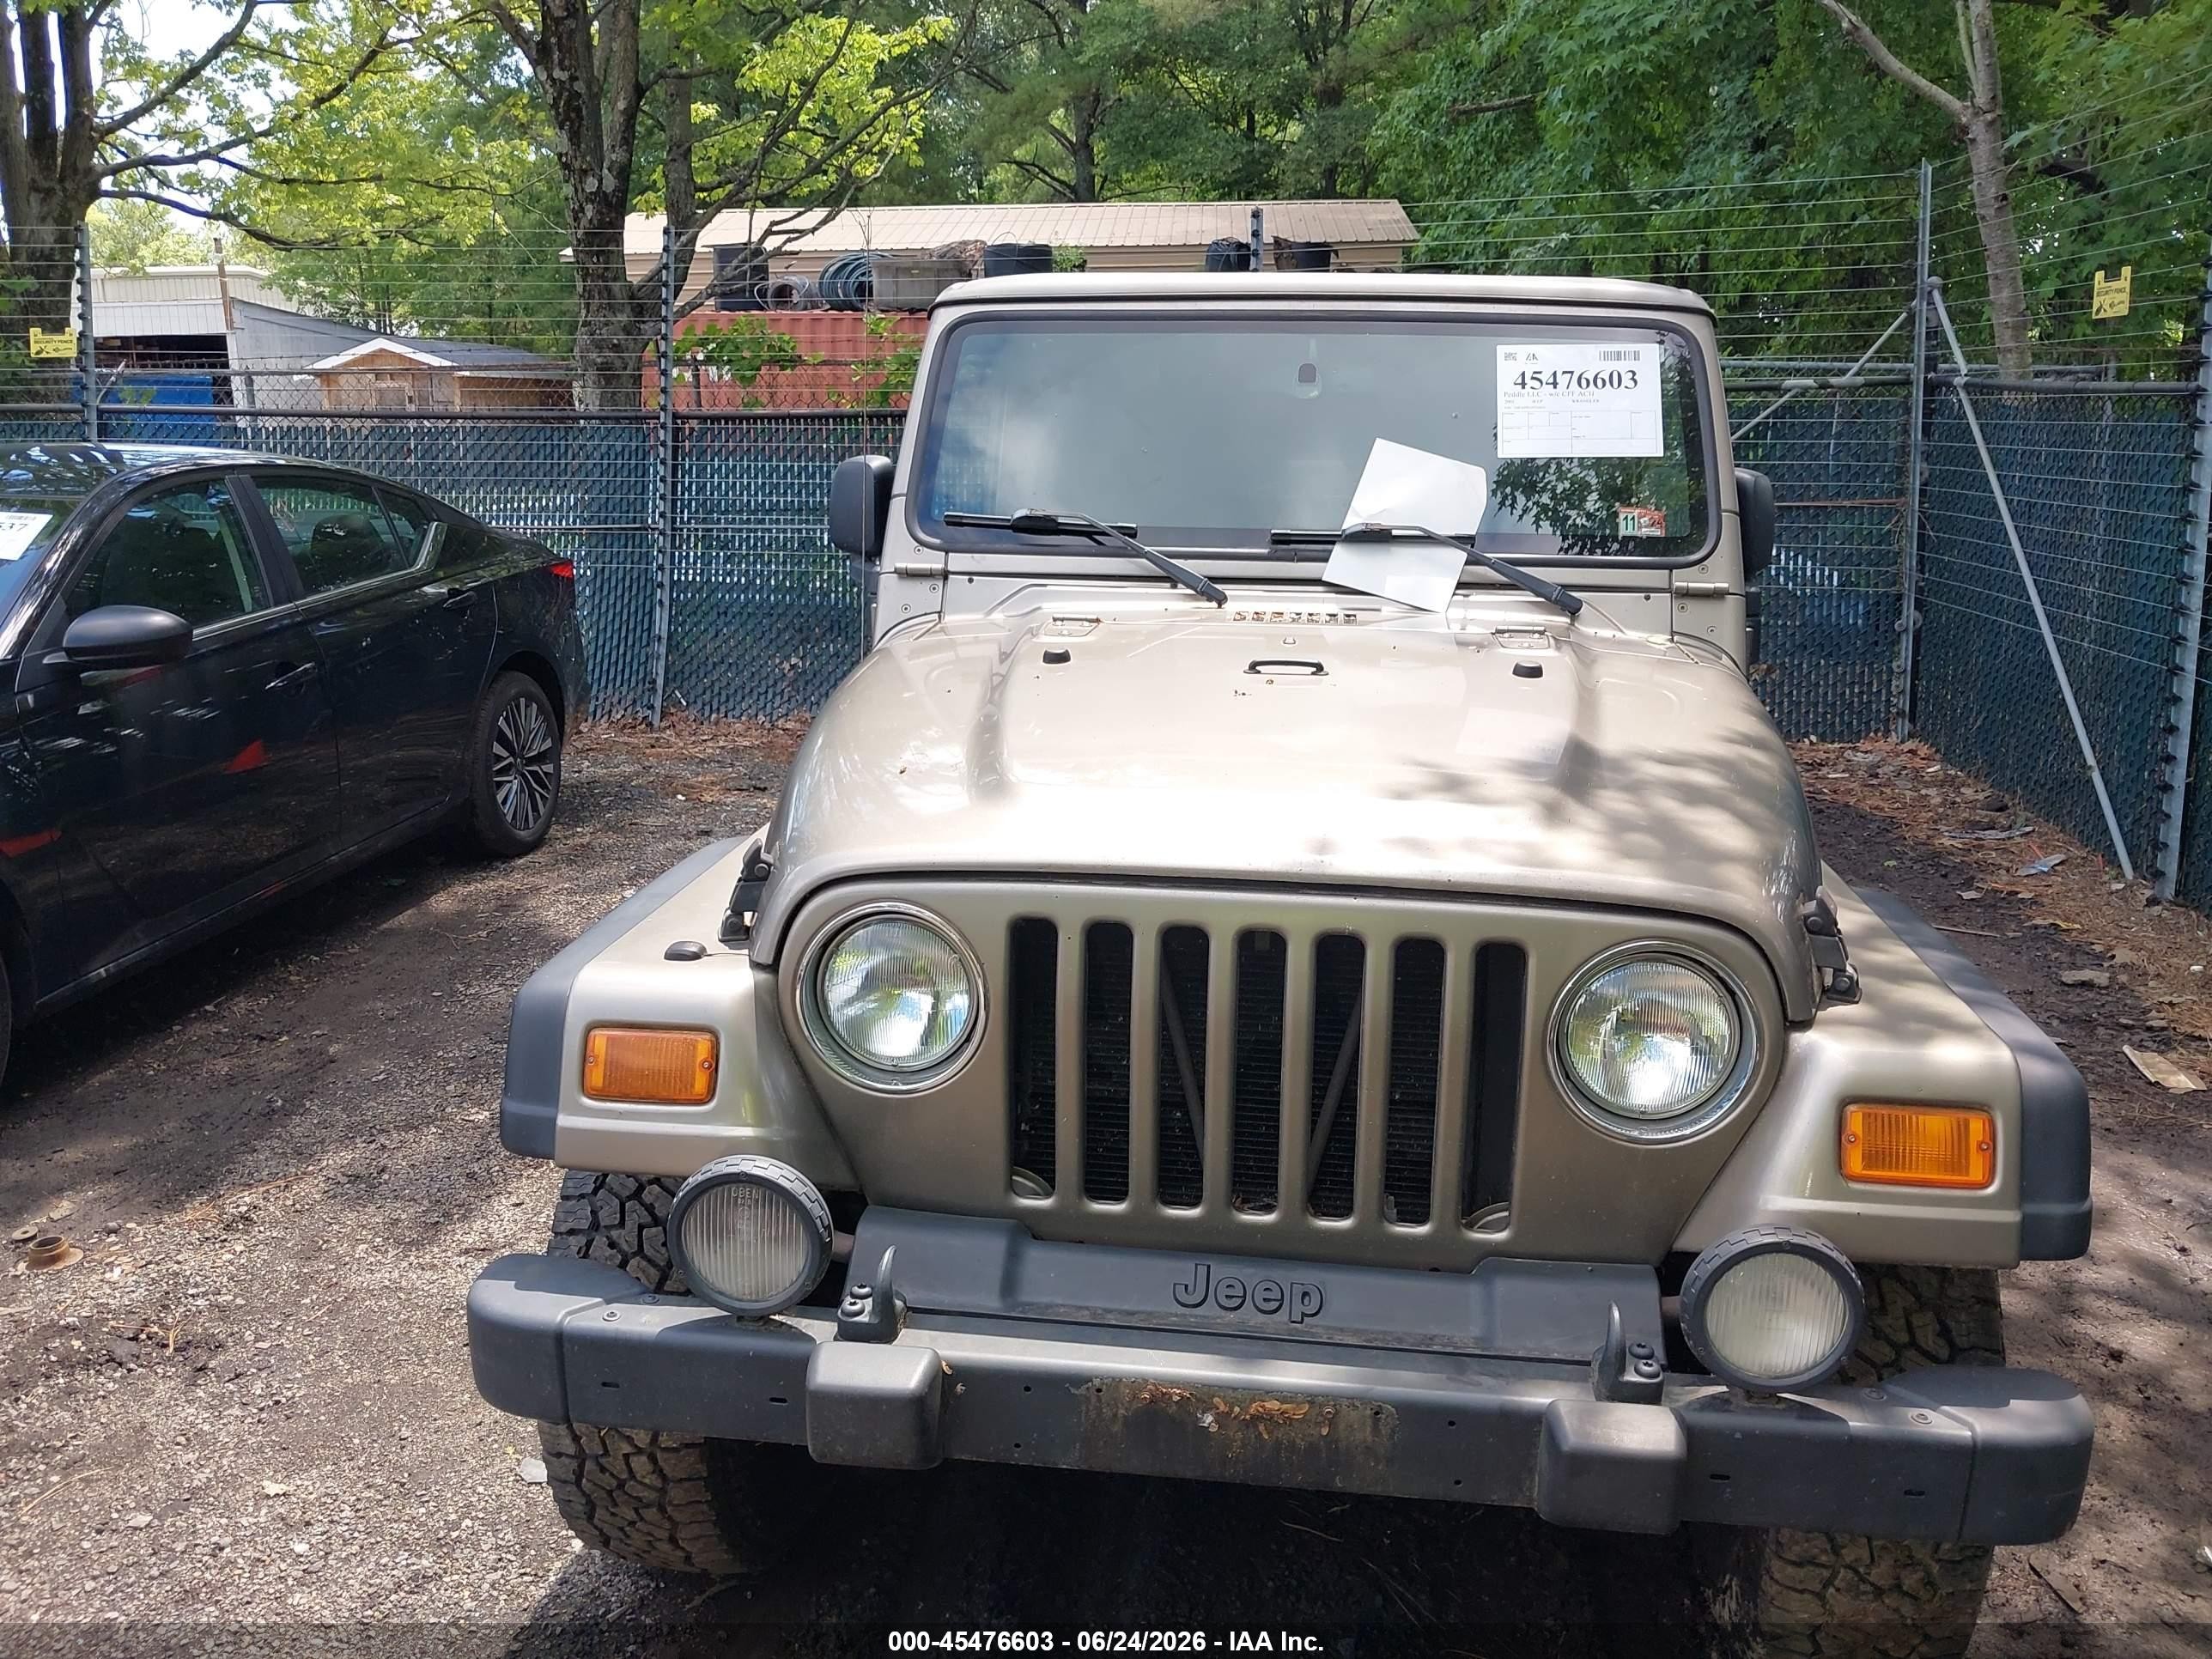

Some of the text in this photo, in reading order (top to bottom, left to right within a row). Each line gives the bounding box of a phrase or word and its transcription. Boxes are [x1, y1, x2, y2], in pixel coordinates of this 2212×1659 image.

[1513, 369, 1638, 390] 45476603
[1622, 514, 1635, 532] 11
[1172, 1262, 1325, 1325] Jeep
